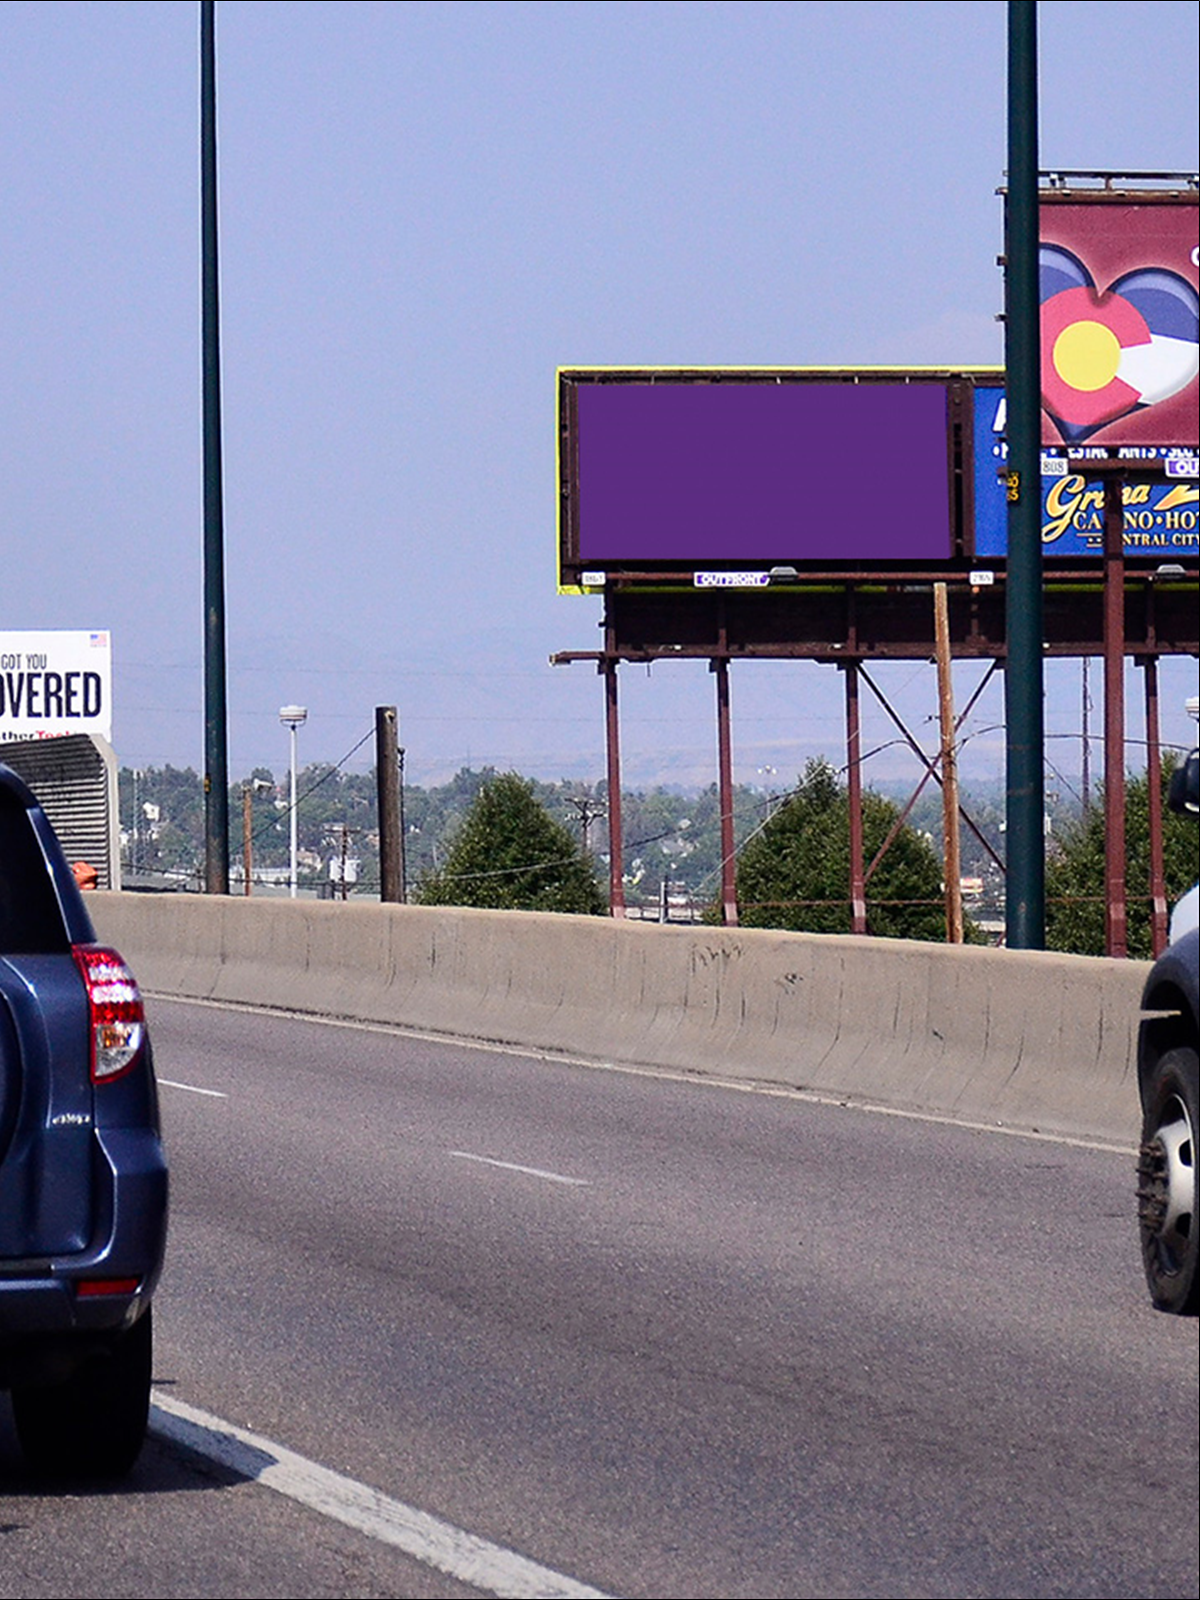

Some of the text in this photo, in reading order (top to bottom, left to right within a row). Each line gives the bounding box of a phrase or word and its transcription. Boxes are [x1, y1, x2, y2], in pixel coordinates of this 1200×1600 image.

[1073, 511, 1199, 529] CANO HO
[1122, 533, 1169, 546] NTRAL
[1, 654, 22, 670] GOT
[26, 654, 47, 670] YOU
